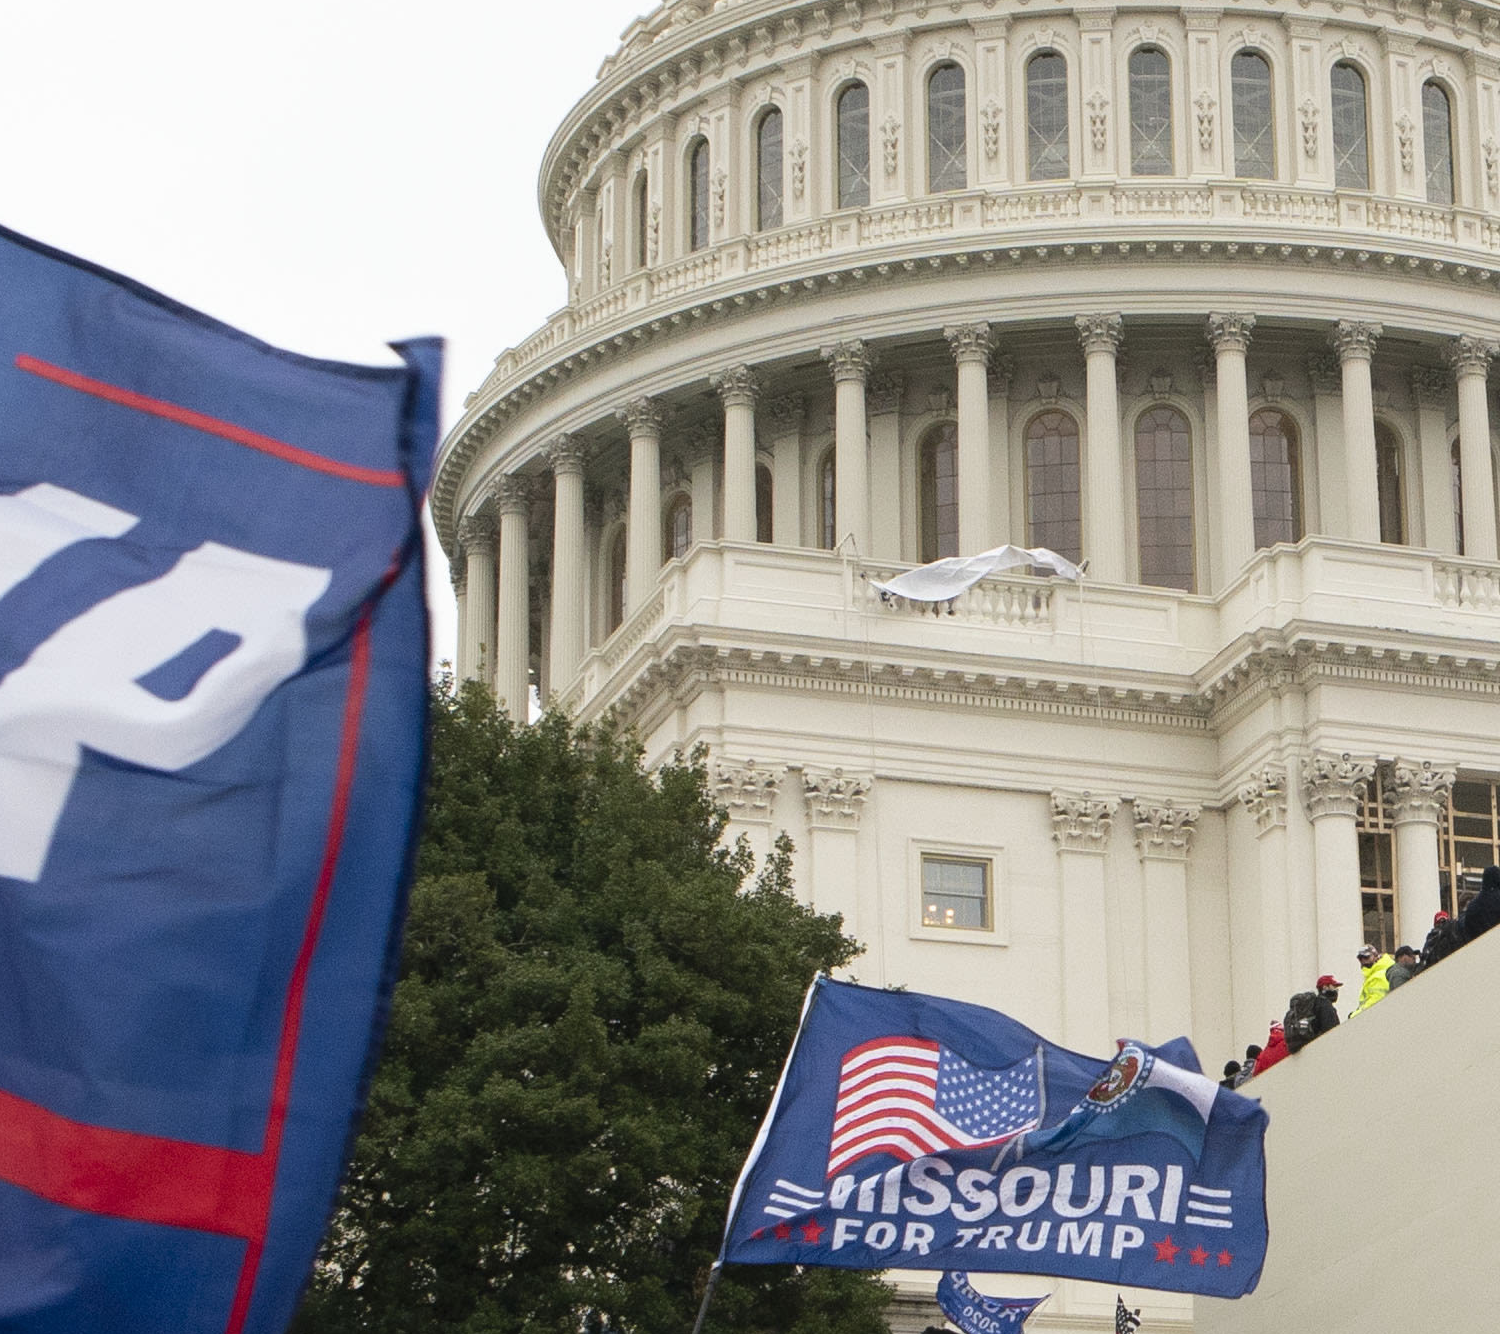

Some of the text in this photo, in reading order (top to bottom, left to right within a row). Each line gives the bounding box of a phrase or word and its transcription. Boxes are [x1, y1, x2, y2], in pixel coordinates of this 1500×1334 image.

[828, 1156, 1183, 1225] MISSOURI
[831, 1217, 1145, 1260] FOR TRUMP
